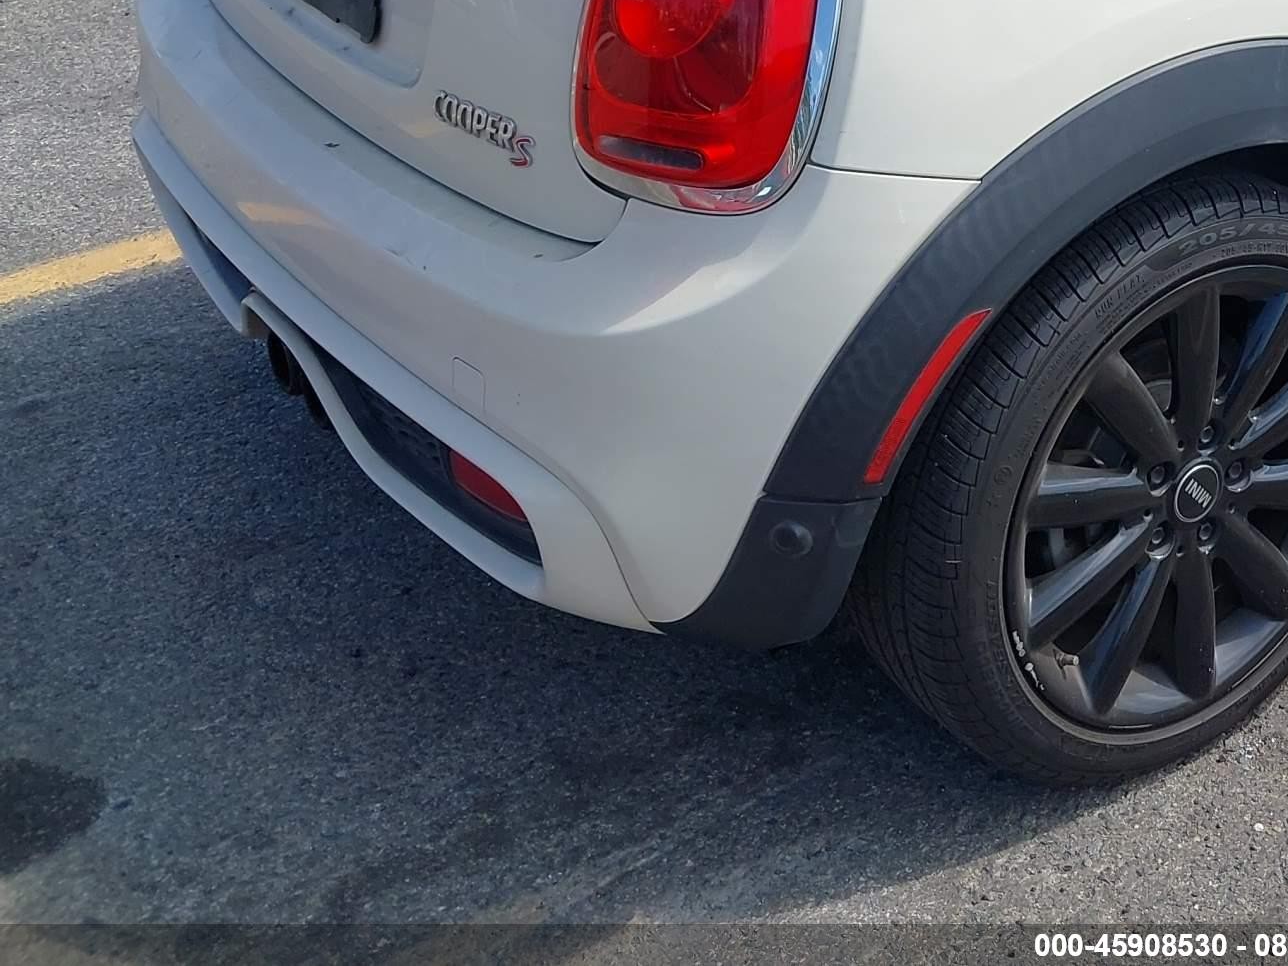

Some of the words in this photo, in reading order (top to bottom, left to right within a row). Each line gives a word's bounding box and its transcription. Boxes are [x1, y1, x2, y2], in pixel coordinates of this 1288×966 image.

[433, 90, 516, 152] COOPER
[510, 136, 536, 168] S
[1184, 477, 1212, 509] MINI
